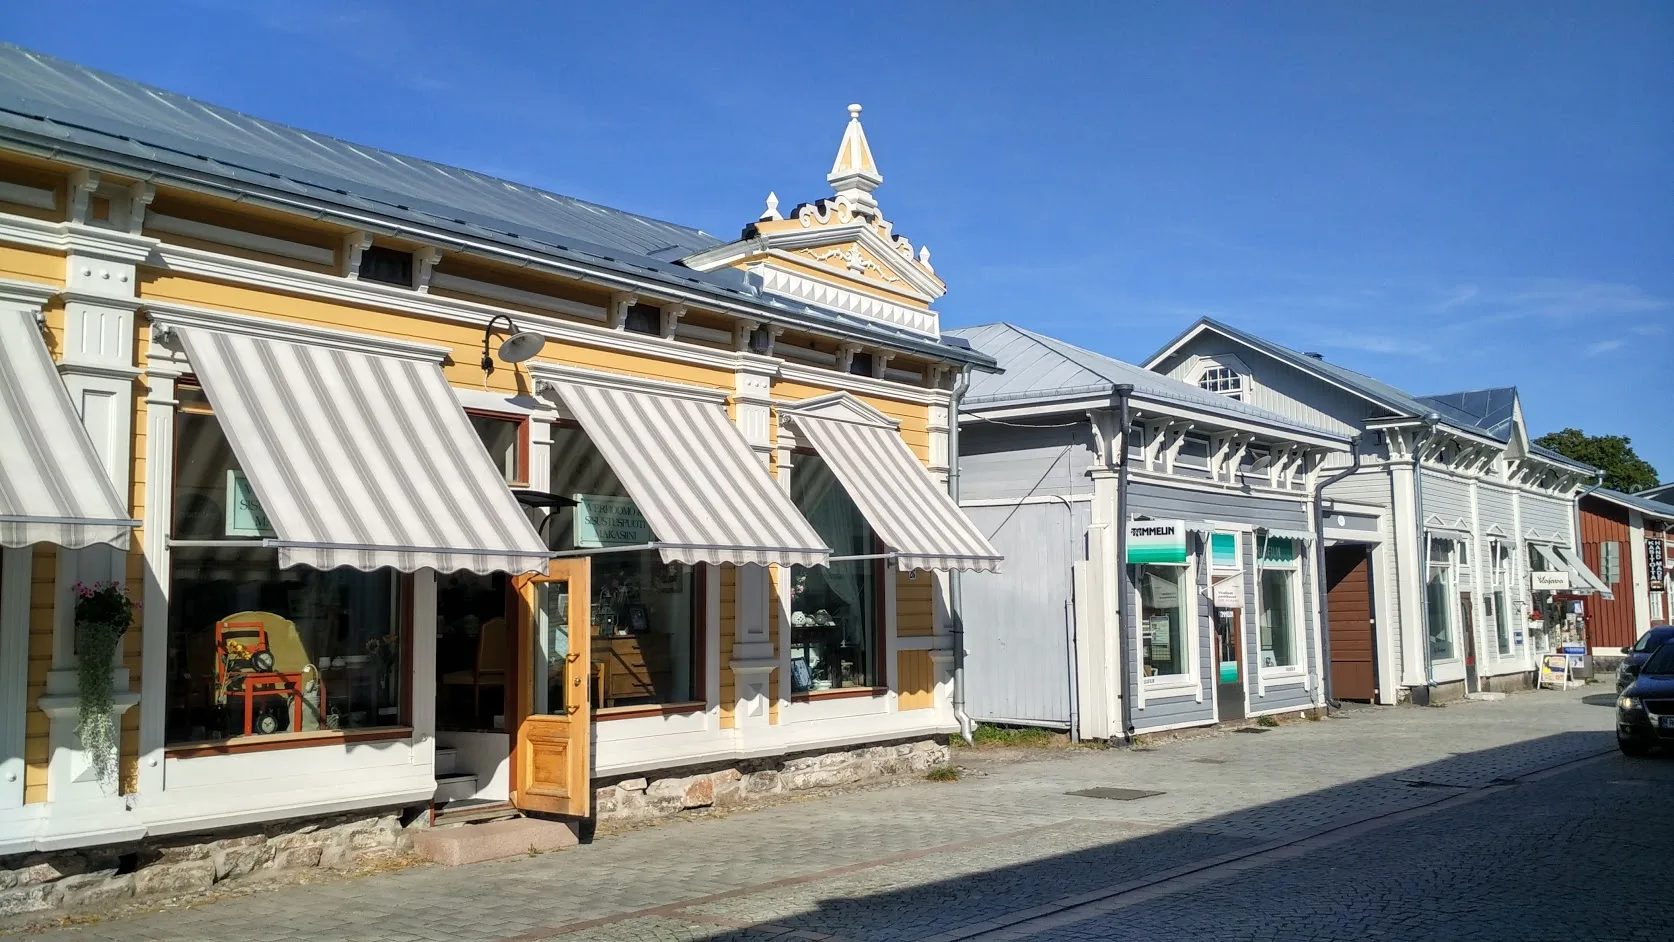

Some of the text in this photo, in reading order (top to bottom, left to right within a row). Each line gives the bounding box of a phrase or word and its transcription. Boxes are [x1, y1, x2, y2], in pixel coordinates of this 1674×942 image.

[586, 503, 636, 516] VERHOOMO
[584, 515, 646, 529] SISUSTUSPUOTI
[594, 529, 637, 541] MAKASIINI
[1130, 526, 1175, 537] TAMMELIN
